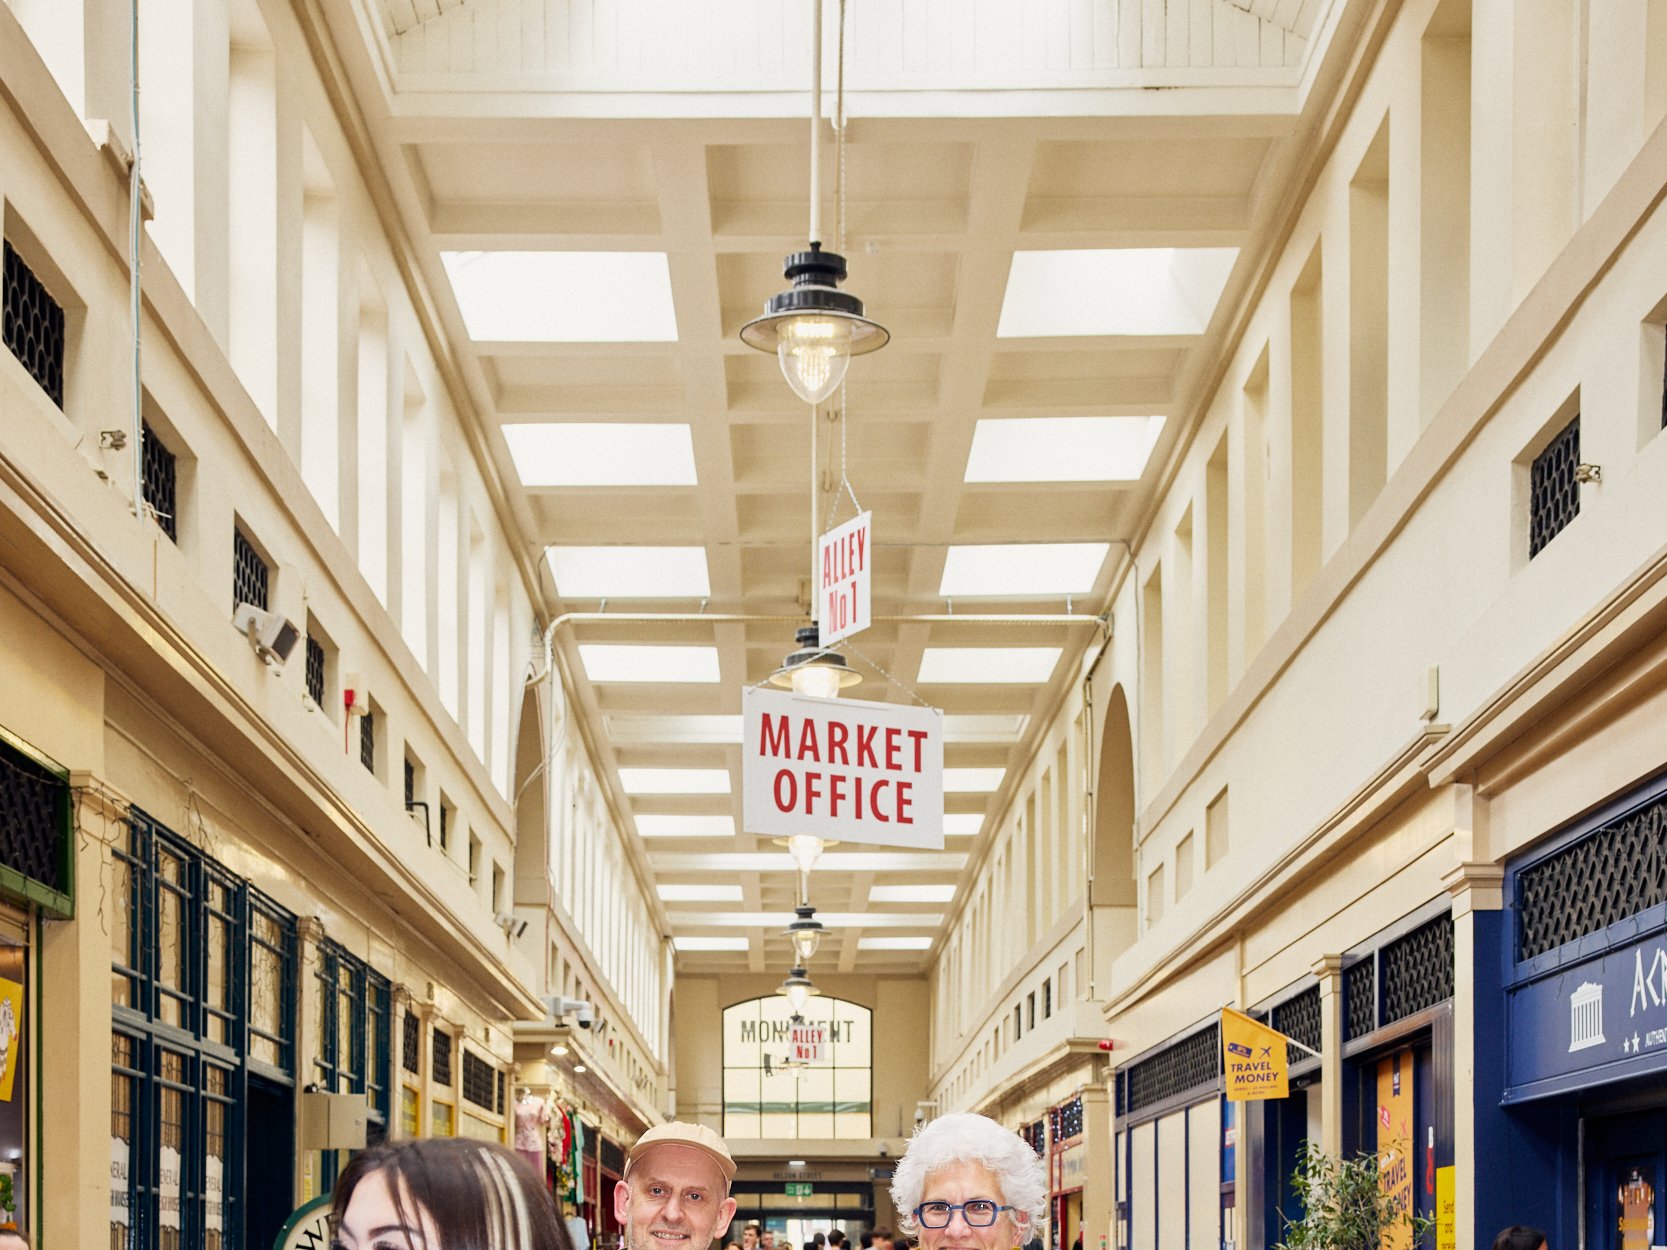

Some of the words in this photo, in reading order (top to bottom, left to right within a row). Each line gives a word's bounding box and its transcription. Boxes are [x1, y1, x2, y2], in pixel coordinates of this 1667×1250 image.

[823, 527, 866, 589] ALLEY
[759, 713, 928, 773] MARKET
[773, 769, 914, 825] OFFICE
[792, 1029, 823, 1043] ALLEY
[1231, 1062, 1271, 1072] TRAVEL
[1235, 1072, 1278, 1083] MONEY
[1383, 1157, 1406, 1193] TRAVEL
